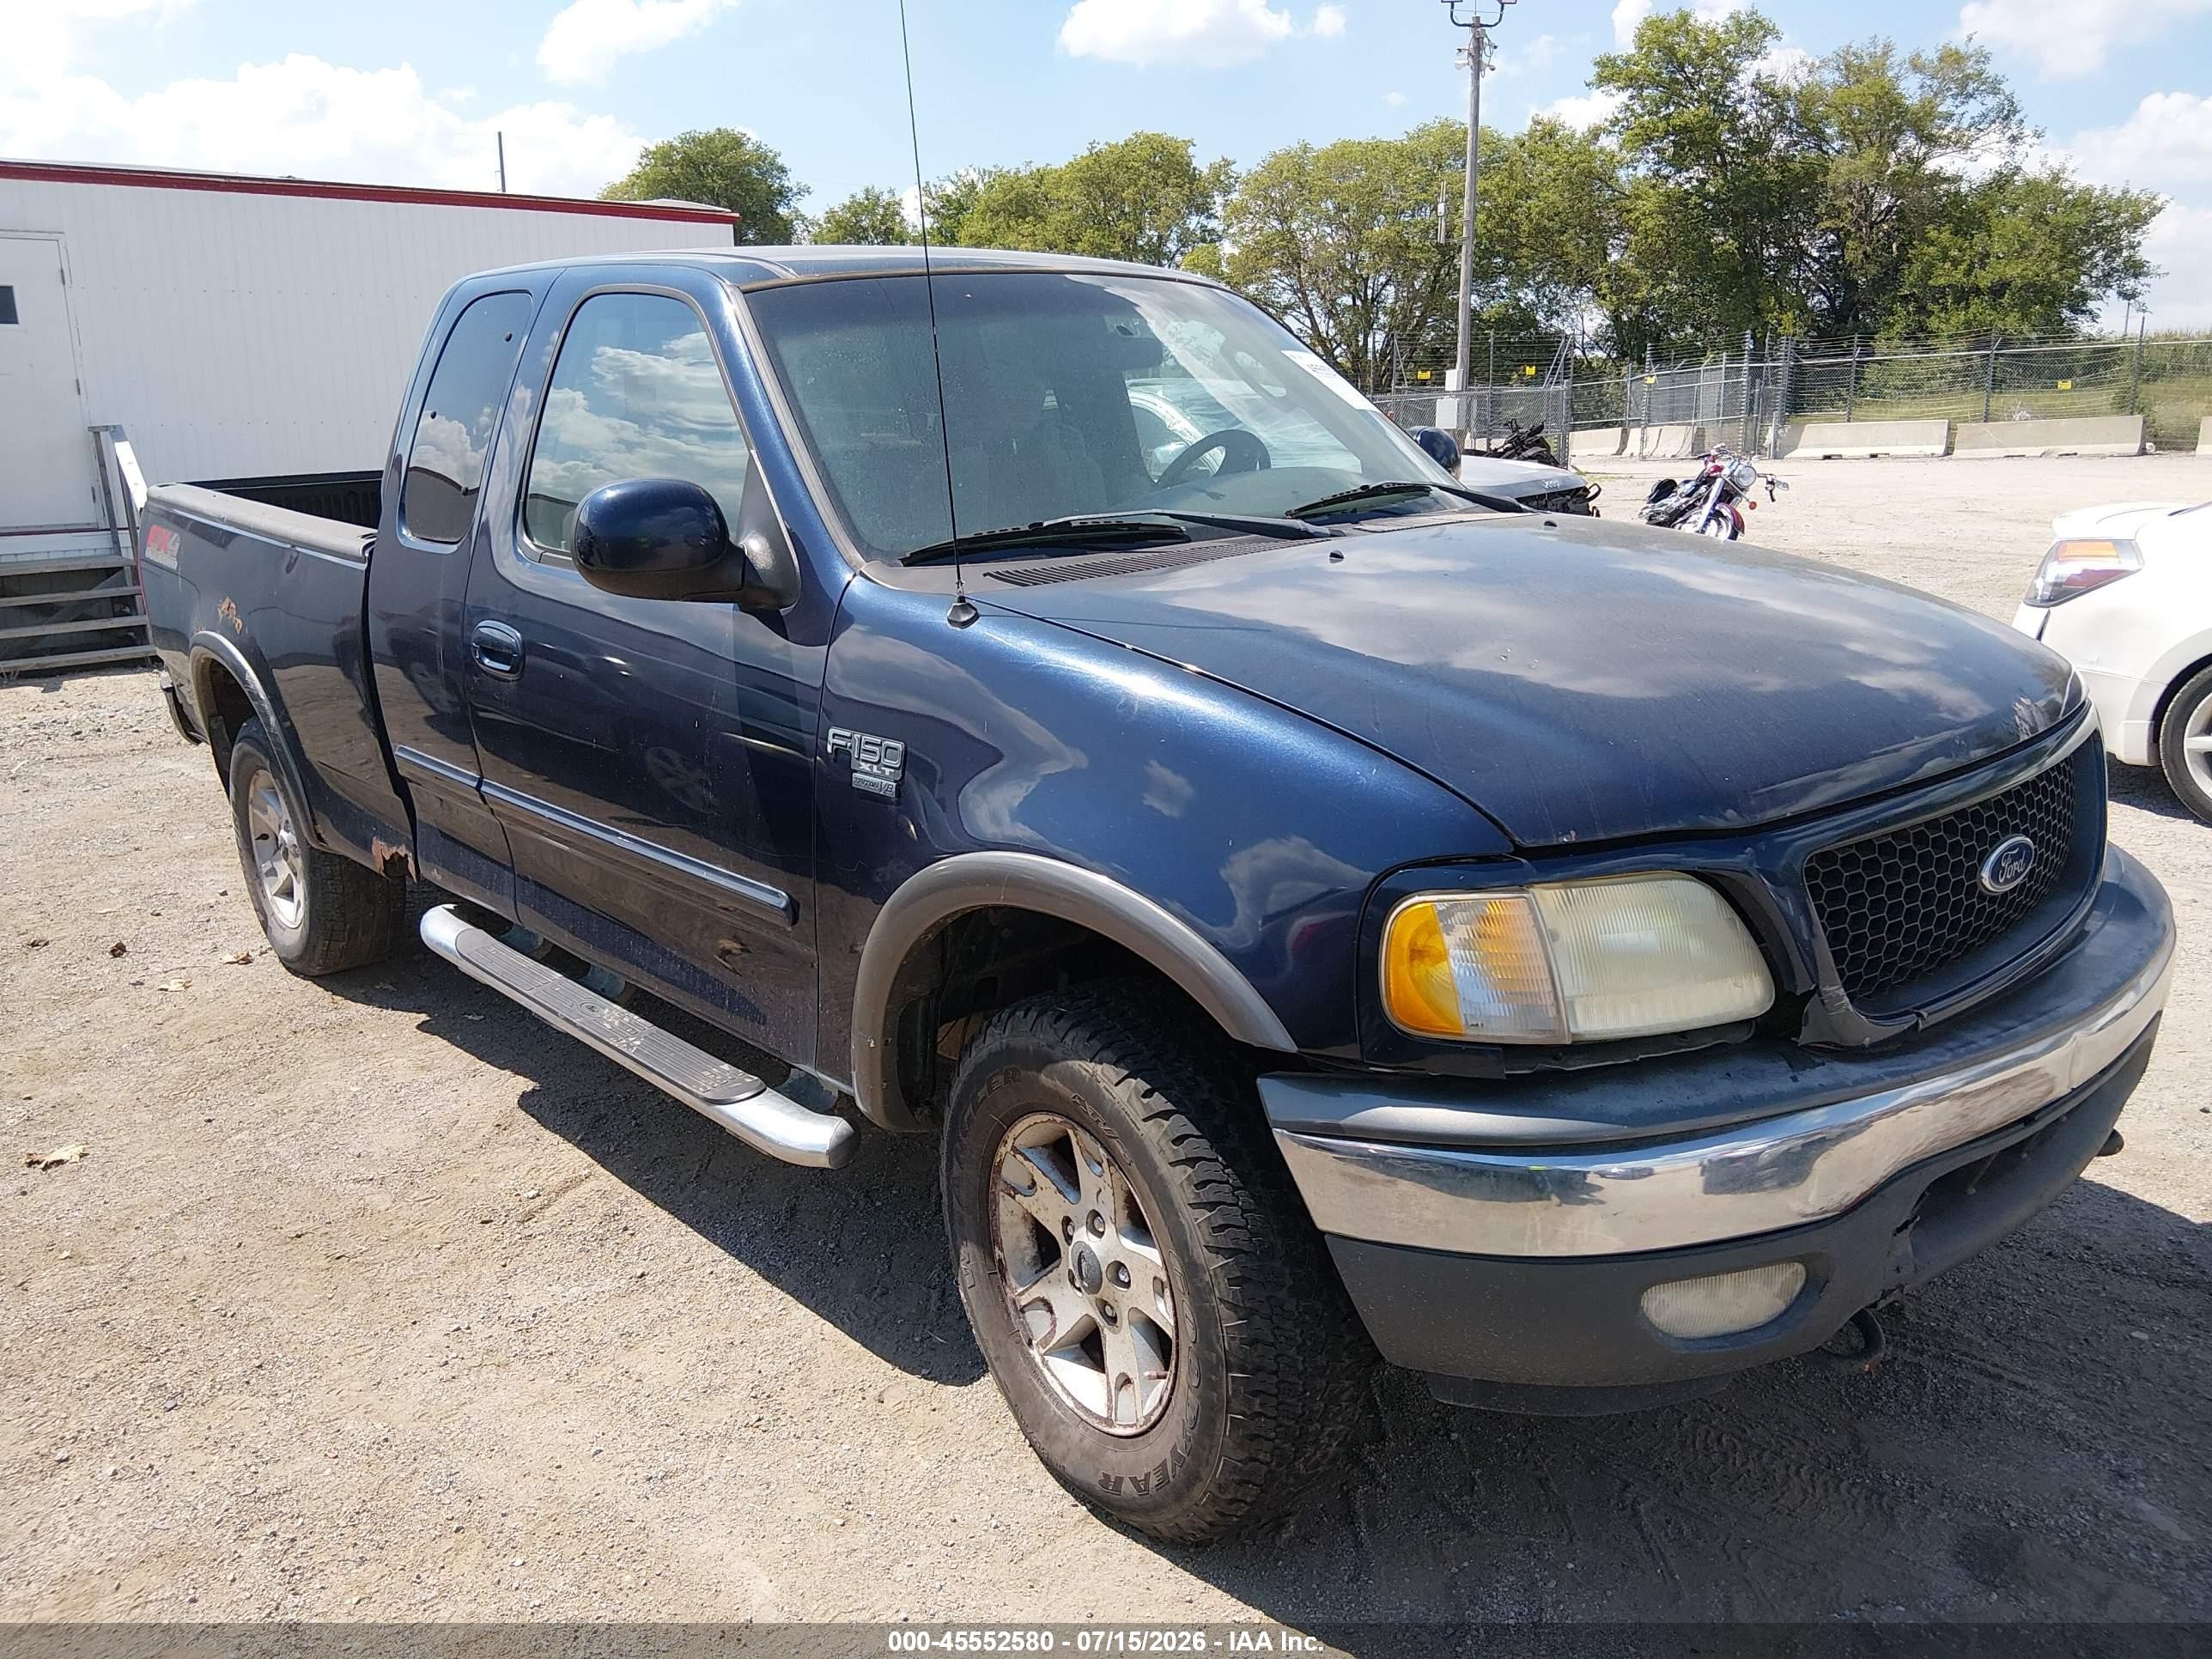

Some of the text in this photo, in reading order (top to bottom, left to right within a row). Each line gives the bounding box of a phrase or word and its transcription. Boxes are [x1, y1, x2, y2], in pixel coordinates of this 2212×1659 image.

[146, 523, 179, 558] FX4
[826, 726, 902, 768] F-150
[859, 762, 895, 776] XLT
[880, 781, 894, 794] V8
[1998, 847, 2026, 883] Ford
